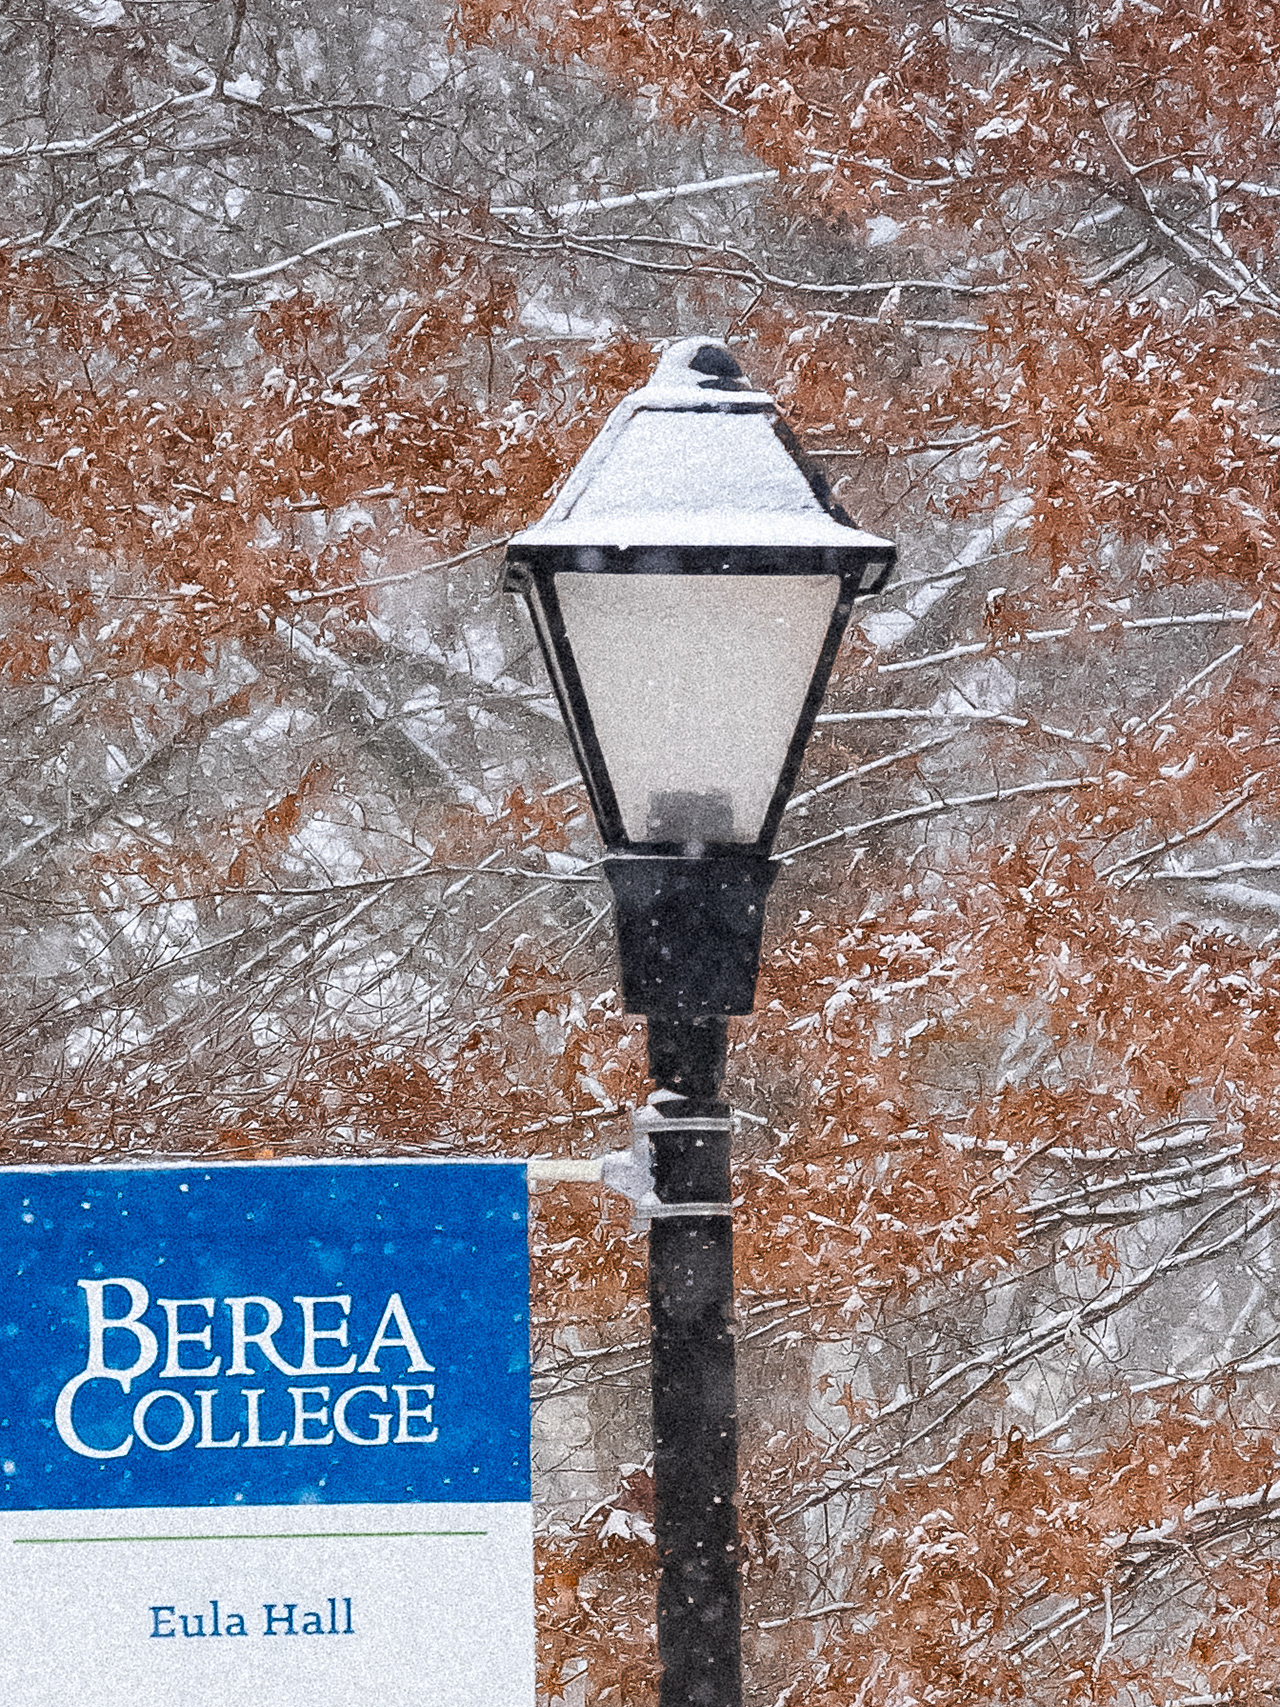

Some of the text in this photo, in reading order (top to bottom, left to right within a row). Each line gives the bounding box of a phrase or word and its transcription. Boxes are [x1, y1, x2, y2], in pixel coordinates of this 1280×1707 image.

[77, 1278, 435, 1379] BEREA
[54, 1370, 439, 1458] COLLEGE
[149, 1598, 356, 1638] Eula Hall
